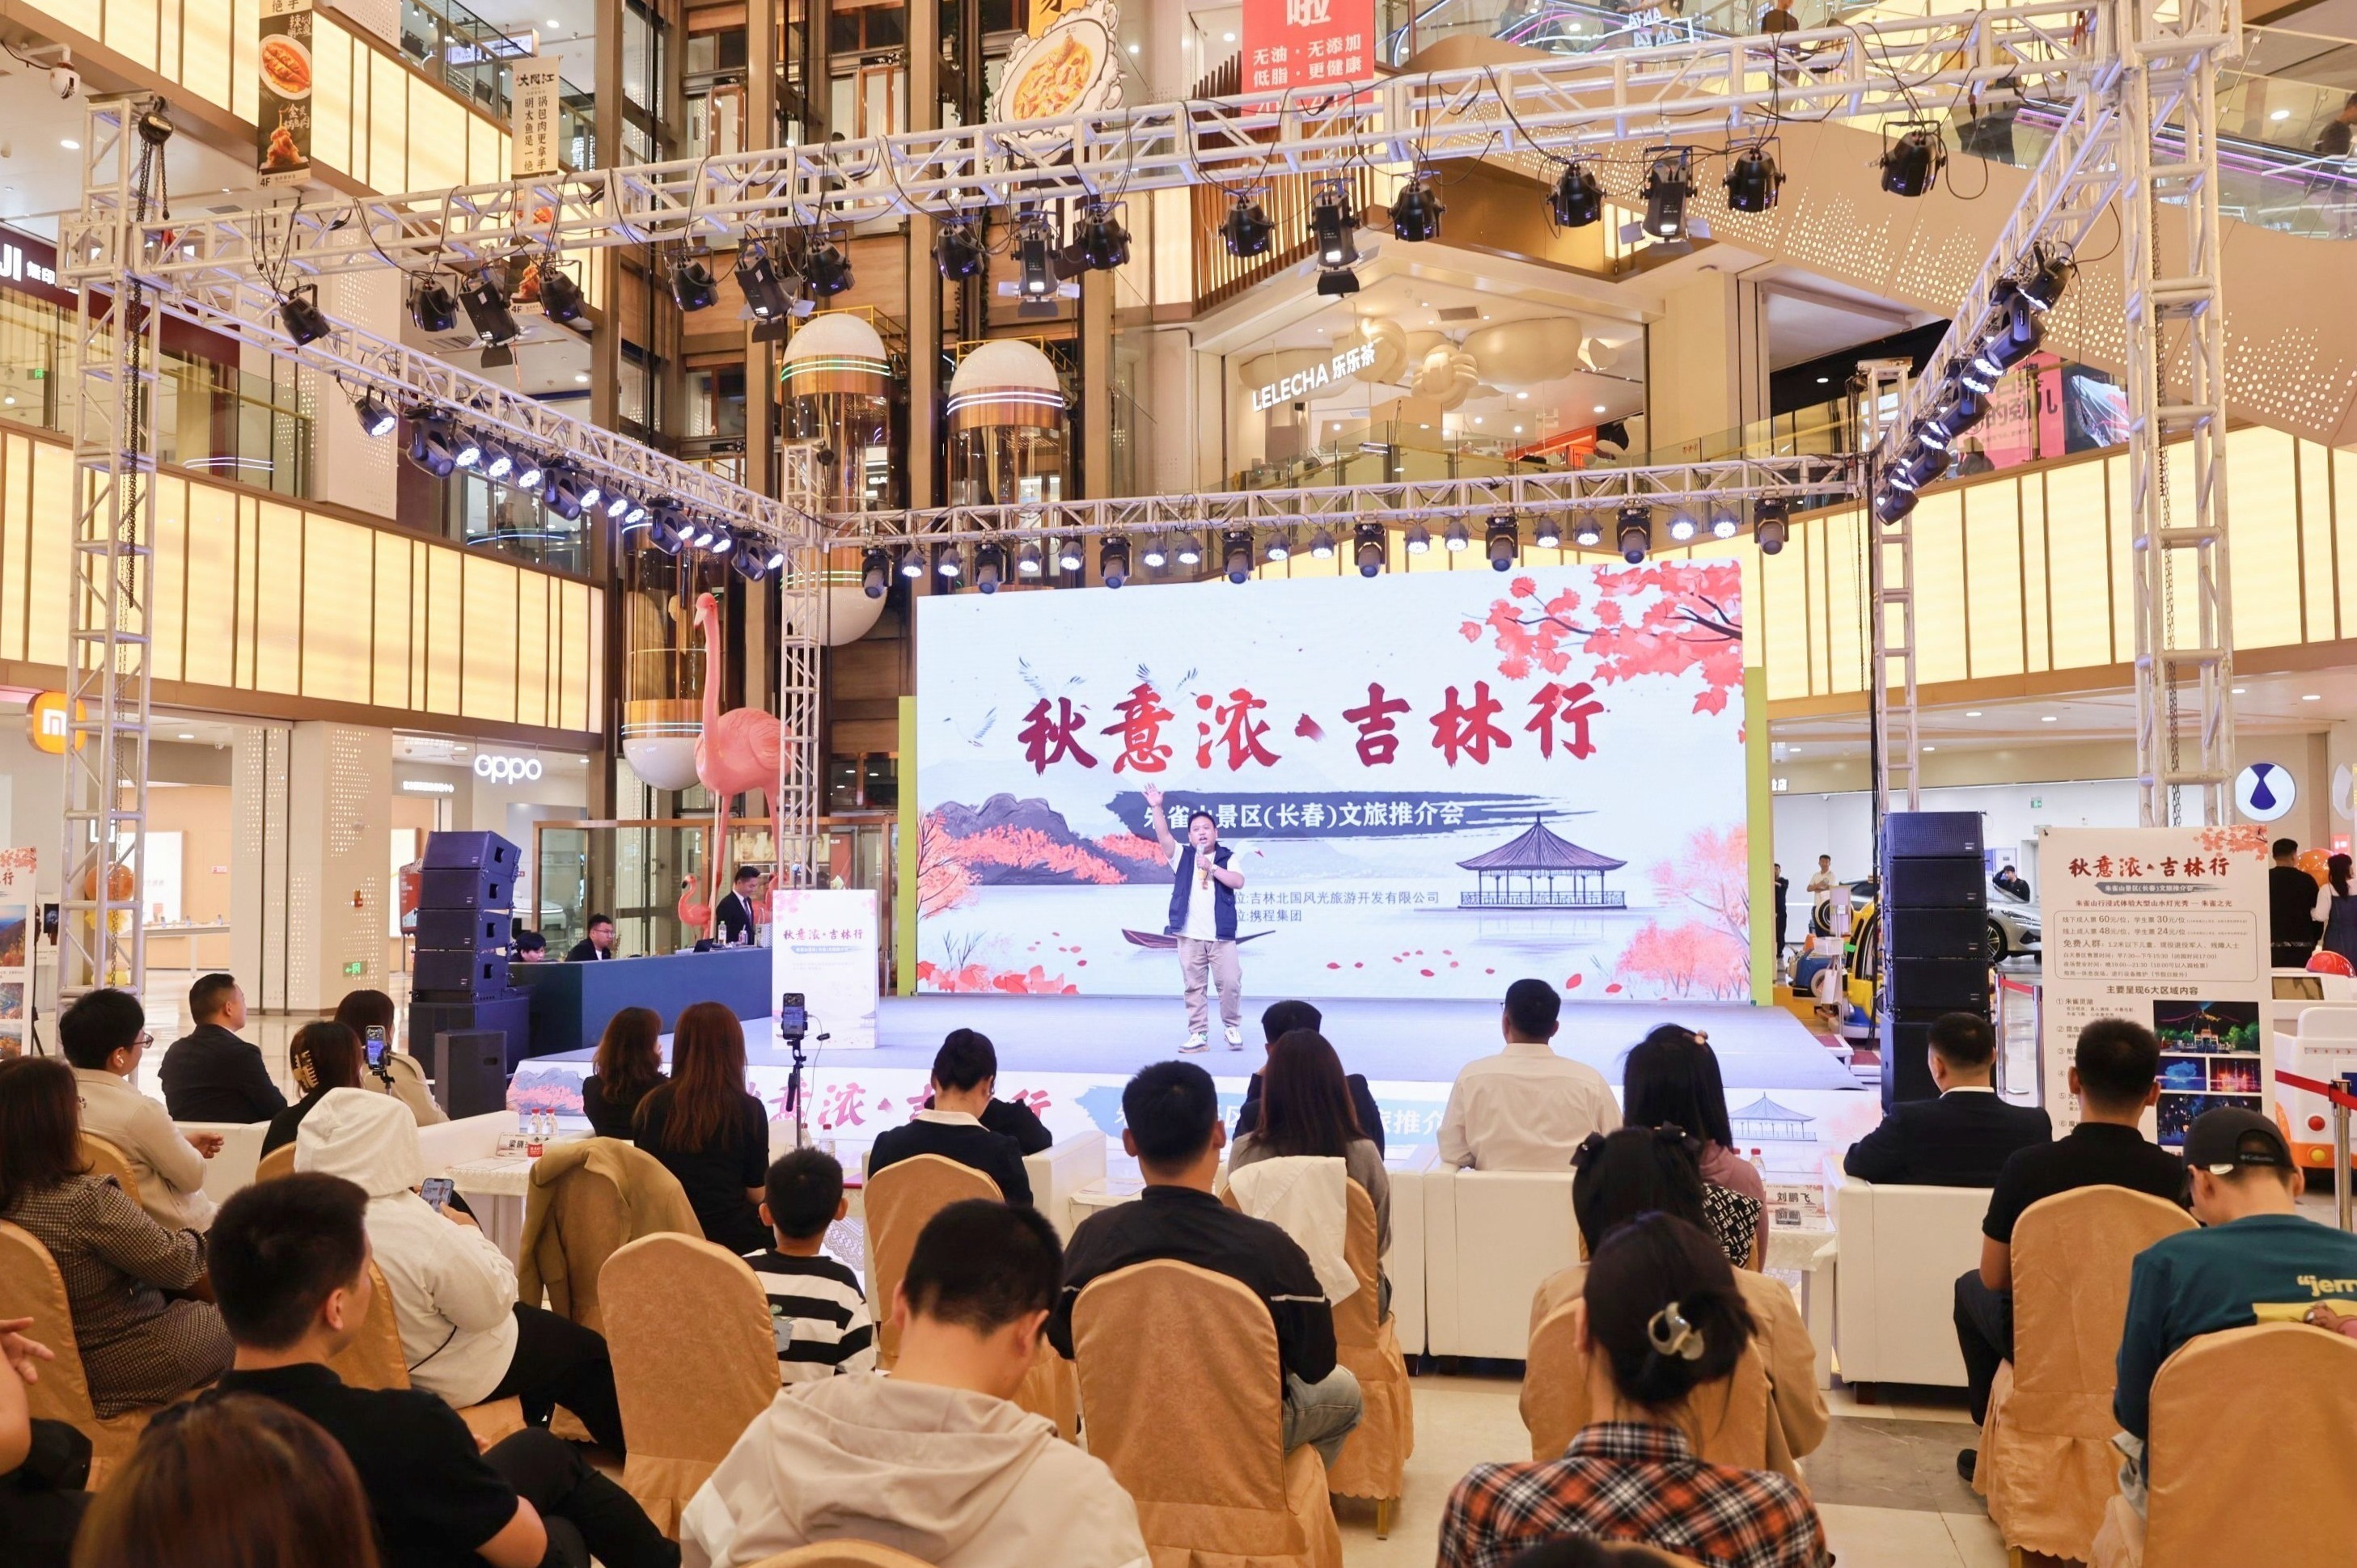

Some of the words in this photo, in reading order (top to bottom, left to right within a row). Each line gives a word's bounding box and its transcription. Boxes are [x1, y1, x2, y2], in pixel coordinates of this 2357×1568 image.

[260, 177, 271, 187] 4F
[511, 306, 522, 314] 4F
[1252, 363, 1329, 412] LELECHA
[1332, 341, 1375, 379] 乐乐茶
[2, 872, 15, 886] 行
[1776, 1191, 1811, 1202] 刘鹏飞
